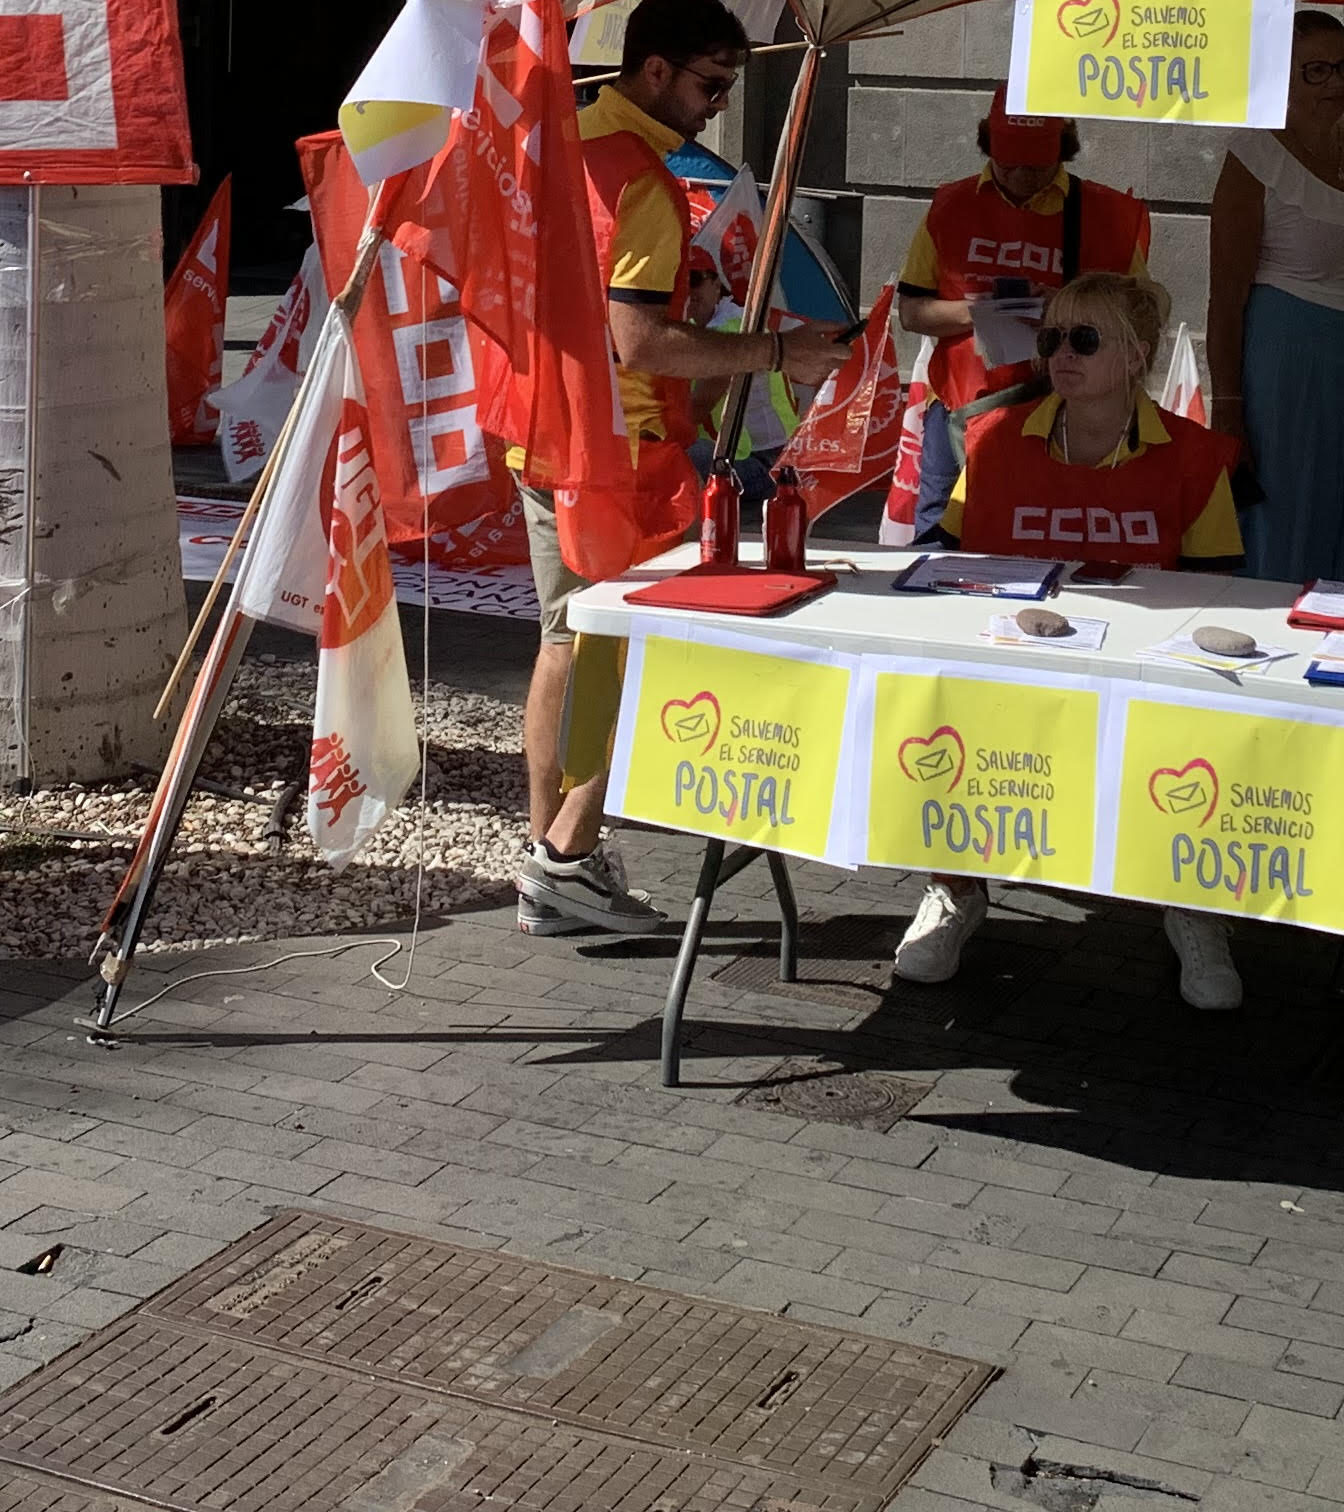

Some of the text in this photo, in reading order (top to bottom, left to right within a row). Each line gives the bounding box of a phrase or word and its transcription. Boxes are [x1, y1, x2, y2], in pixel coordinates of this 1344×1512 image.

[1131, 5, 1206, 28] SALVEMOS
[1122, 32, 1209, 50] EL SERVICIO
[1078, 53, 1209, 108] POSTAL
[1012, 506, 1160, 544] CCOO
[281, 589, 310, 610] UGT
[729, 715, 801, 748] SALVEMOS
[719, 743, 800, 772] EL SERVICIO
[976, 748, 1052, 778] SALVEMOS
[675, 760, 795, 828] POSTAL
[967, 778, 1055, 801] EL SERVICIO
[1230, 783, 1313, 816] SALVEMOS
[922, 799, 1057, 864] POSTAL
[1219, 813, 1314, 840] EL SERVICIO
[1172, 833, 1314, 901] POSTAL
